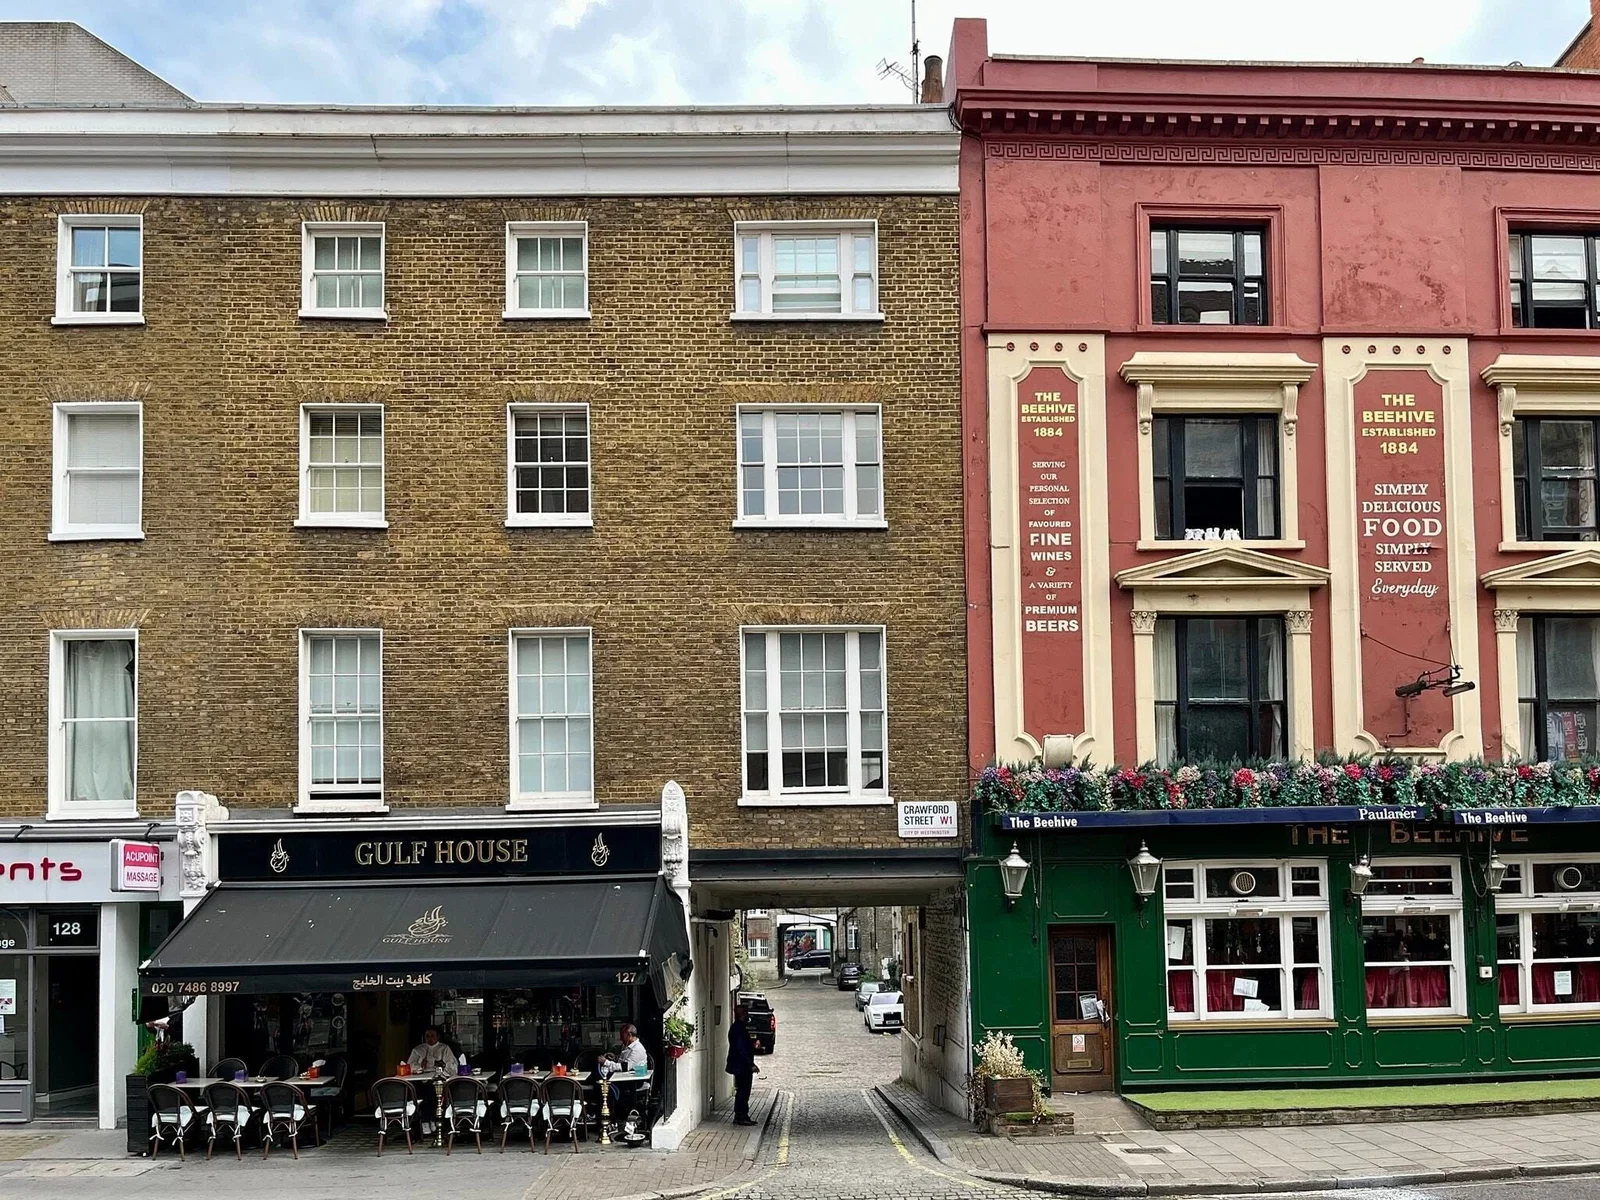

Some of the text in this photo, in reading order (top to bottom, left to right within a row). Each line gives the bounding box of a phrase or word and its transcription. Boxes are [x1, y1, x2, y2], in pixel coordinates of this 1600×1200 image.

[1035, 392, 1061, 402] THE
[1381, 394, 1415, 406] THE
[1021, 404, 1075, 413] BEEHIVE
[1362, 411, 1435, 423] BEEHIVE
[1033, 427, 1063, 437] 1884
[1362, 428, 1436, 437] ESTABLISHED
[1380, 442, 1418, 454] 1884
[1374, 483, 1429, 495] SIMPLY
[1028, 497, 1070, 505] SELECTION
[1362, 501, 1441, 513] DELICIOUS
[1362, 518, 1442, 537] FOOD
[1030, 533, 1072, 546] FINE
[1375, 542, 1431, 555] SIMPLY
[1030, 551, 1072, 561] WINES
[1045, 566, 1056, 576] &
[1374, 561, 1432, 573] SERVED
[1025, 605, 1077, 614] PREMIUM
[1025, 620, 1079, 632] BEERS
[903, 804, 950, 815] CRAWFORD
[1358, 807, 1417, 820] Paulaner
[904, 816, 953, 825] STREET W1
[1009, 816, 1078, 828] The Beehive
[1461, 811, 1528, 824] The Beehive
[1285, 822, 1350, 846] THE
[125, 850, 159, 864] ACUPOINT
[354, 839, 529, 865] GULF HOUSE
[126, 871, 158, 883] MASSAGE
[52, 922, 81, 936] 128
[352, 972, 433, 990] كافية بيت الخليج
[615, 972, 637, 983] 127
[151, 981, 240, 994] 020 7486 8997
